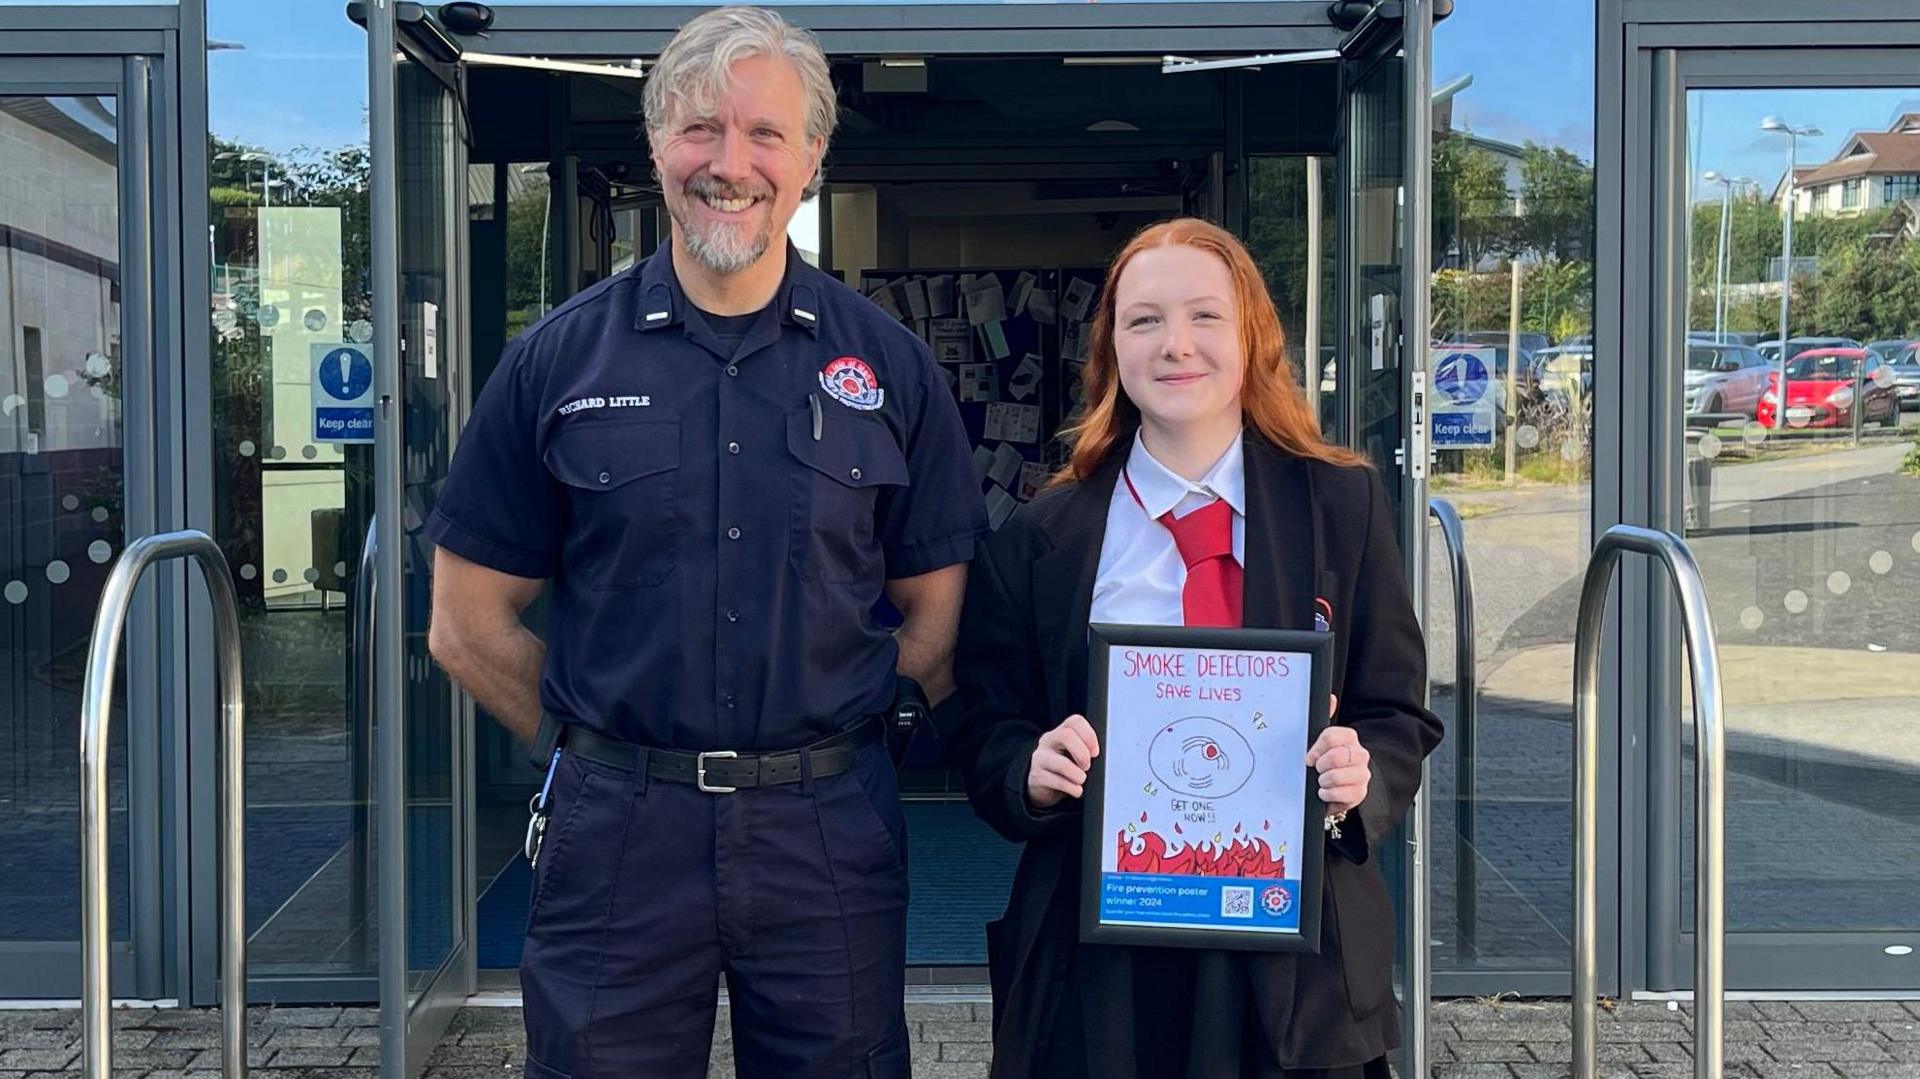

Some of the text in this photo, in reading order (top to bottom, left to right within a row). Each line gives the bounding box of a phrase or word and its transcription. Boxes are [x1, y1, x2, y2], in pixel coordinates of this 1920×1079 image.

[558, 396, 650, 415] RICHARD LITTLE
[319, 417, 373, 431] Keep clear
[1434, 423, 1489, 436] Keep clear
[1123, 649, 1290, 678] SMOKE DETECTORS
[1156, 682, 1242, 701] SAVE LIVES
[1170, 798, 1215, 812] GET ONE
[1106, 883, 1209, 897] Fire prevention poster
[1106, 896, 1163, 907] winner 2024
